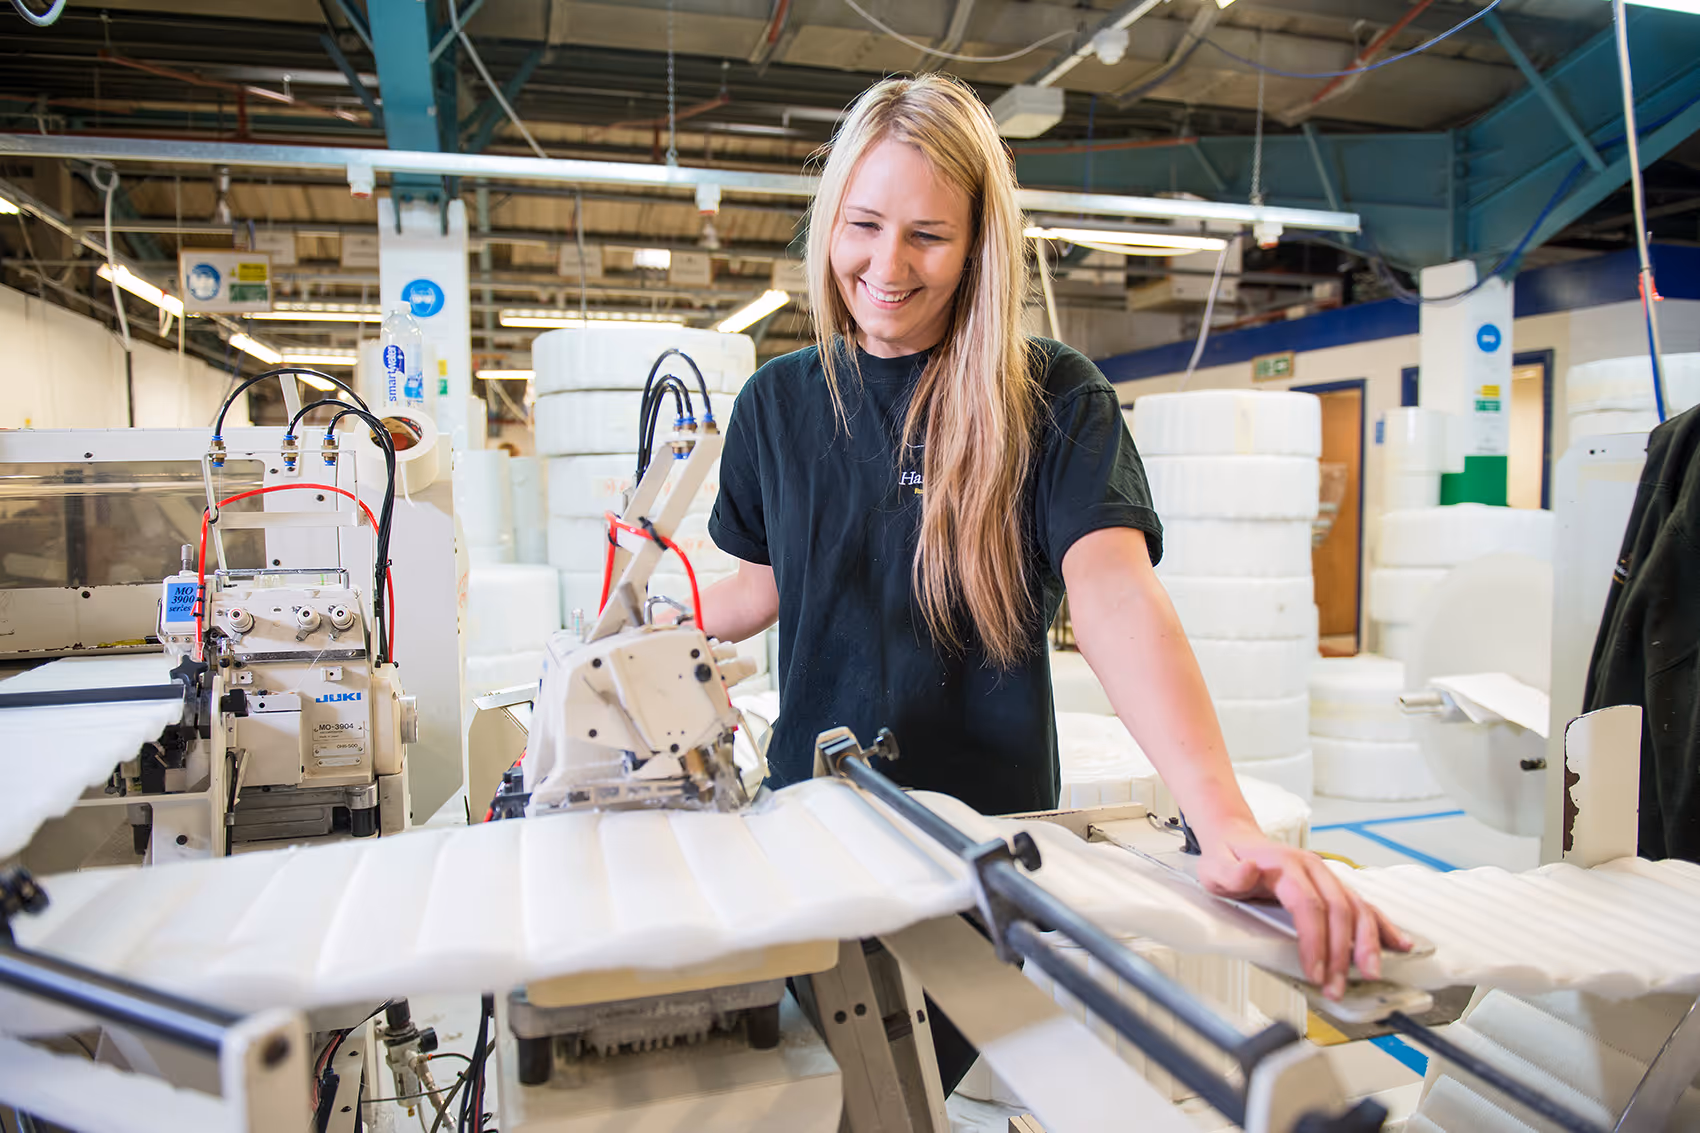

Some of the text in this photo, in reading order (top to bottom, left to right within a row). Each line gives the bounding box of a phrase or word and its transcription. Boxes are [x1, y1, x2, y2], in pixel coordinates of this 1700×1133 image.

[898, 471, 925, 486] Ha
[175, 586, 194, 596] MO
[171, 595, 196, 605] 3900
[168, 604, 192, 612] series
[315, 692, 362, 703] JUKI
[318, 723, 354, 731] MO-3904
